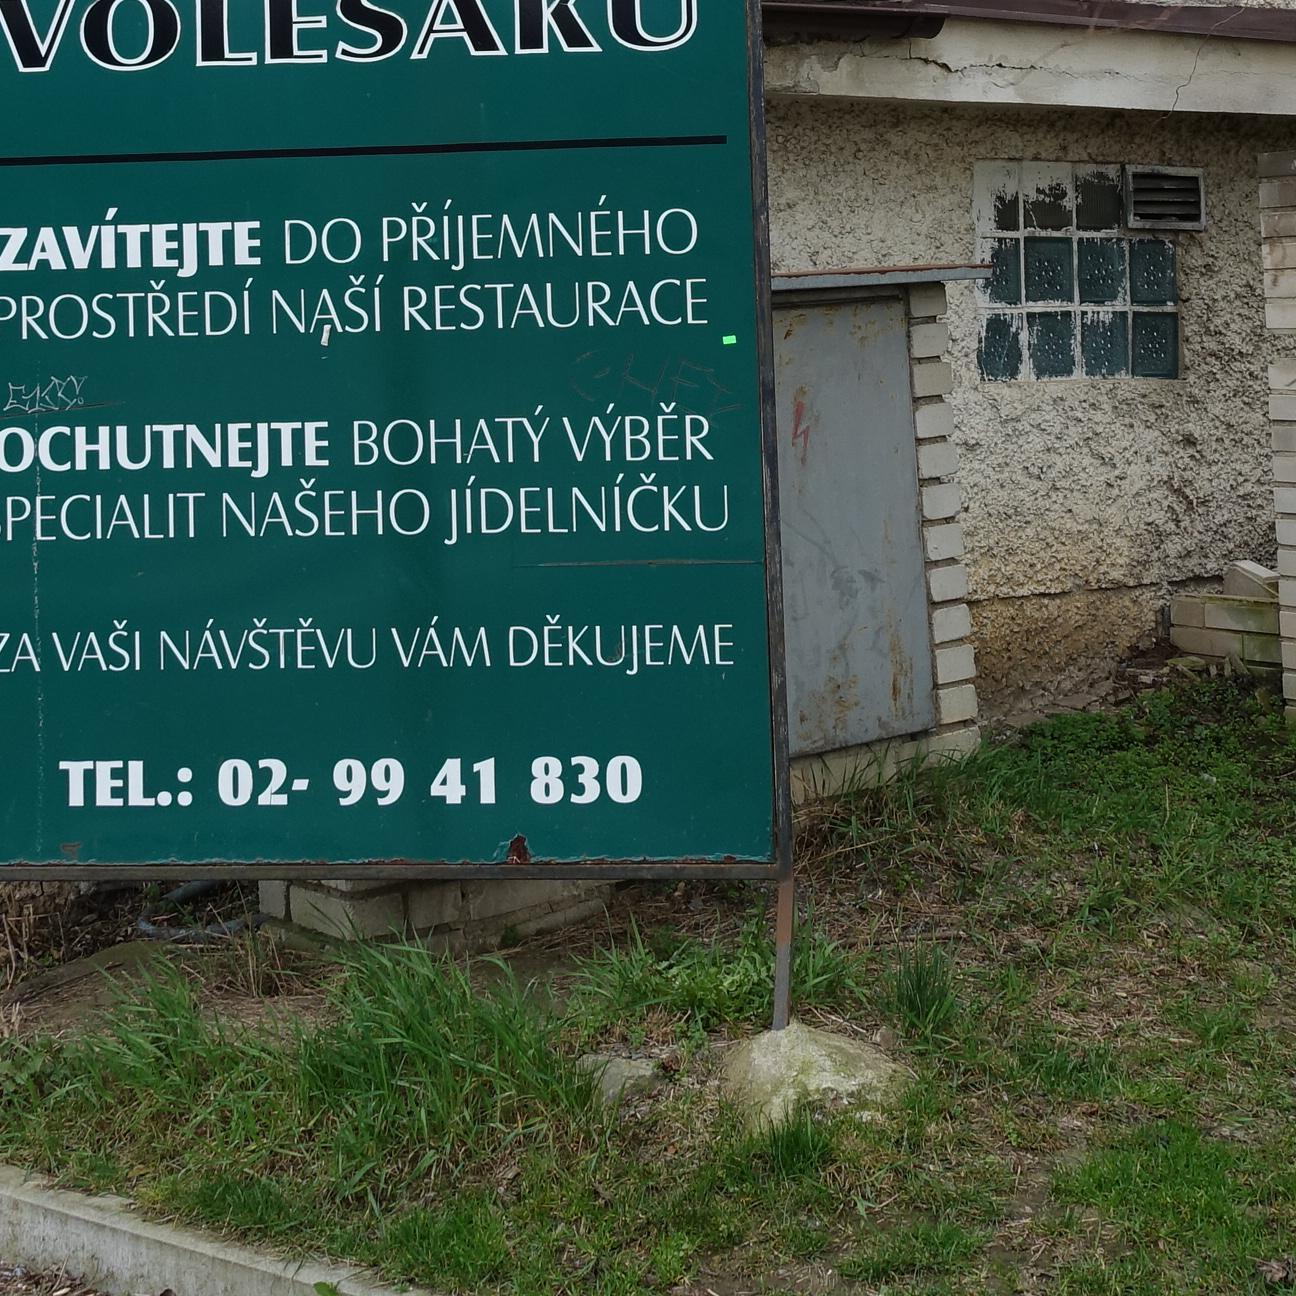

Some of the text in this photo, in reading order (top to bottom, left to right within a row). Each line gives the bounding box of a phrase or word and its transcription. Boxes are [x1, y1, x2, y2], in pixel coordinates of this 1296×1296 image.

[284, 218, 361, 264] DO
[382, 195, 698, 270] PŘÍJEMNÉHO
[272, 274, 384, 334] NAŠÍ
[403, 278, 708, 331] RESTAURACE
[353, 405, 550, 465] BOHATÝ
[562, 402, 714, 461] VÝBĚR
[222, 478, 430, 537] NAŠEHO
[444, 473, 729, 545] JÍDELNÍČKU
[51, 619, 141, 671] VAŠI
[160, 617, 376, 670] NÁVŠTĚVU
[390, 615, 491, 668] VÁM
[508, 614, 734, 675] DĚKUJEME
[58, 755, 643, 807] TEL.: 02- 99 41 830
